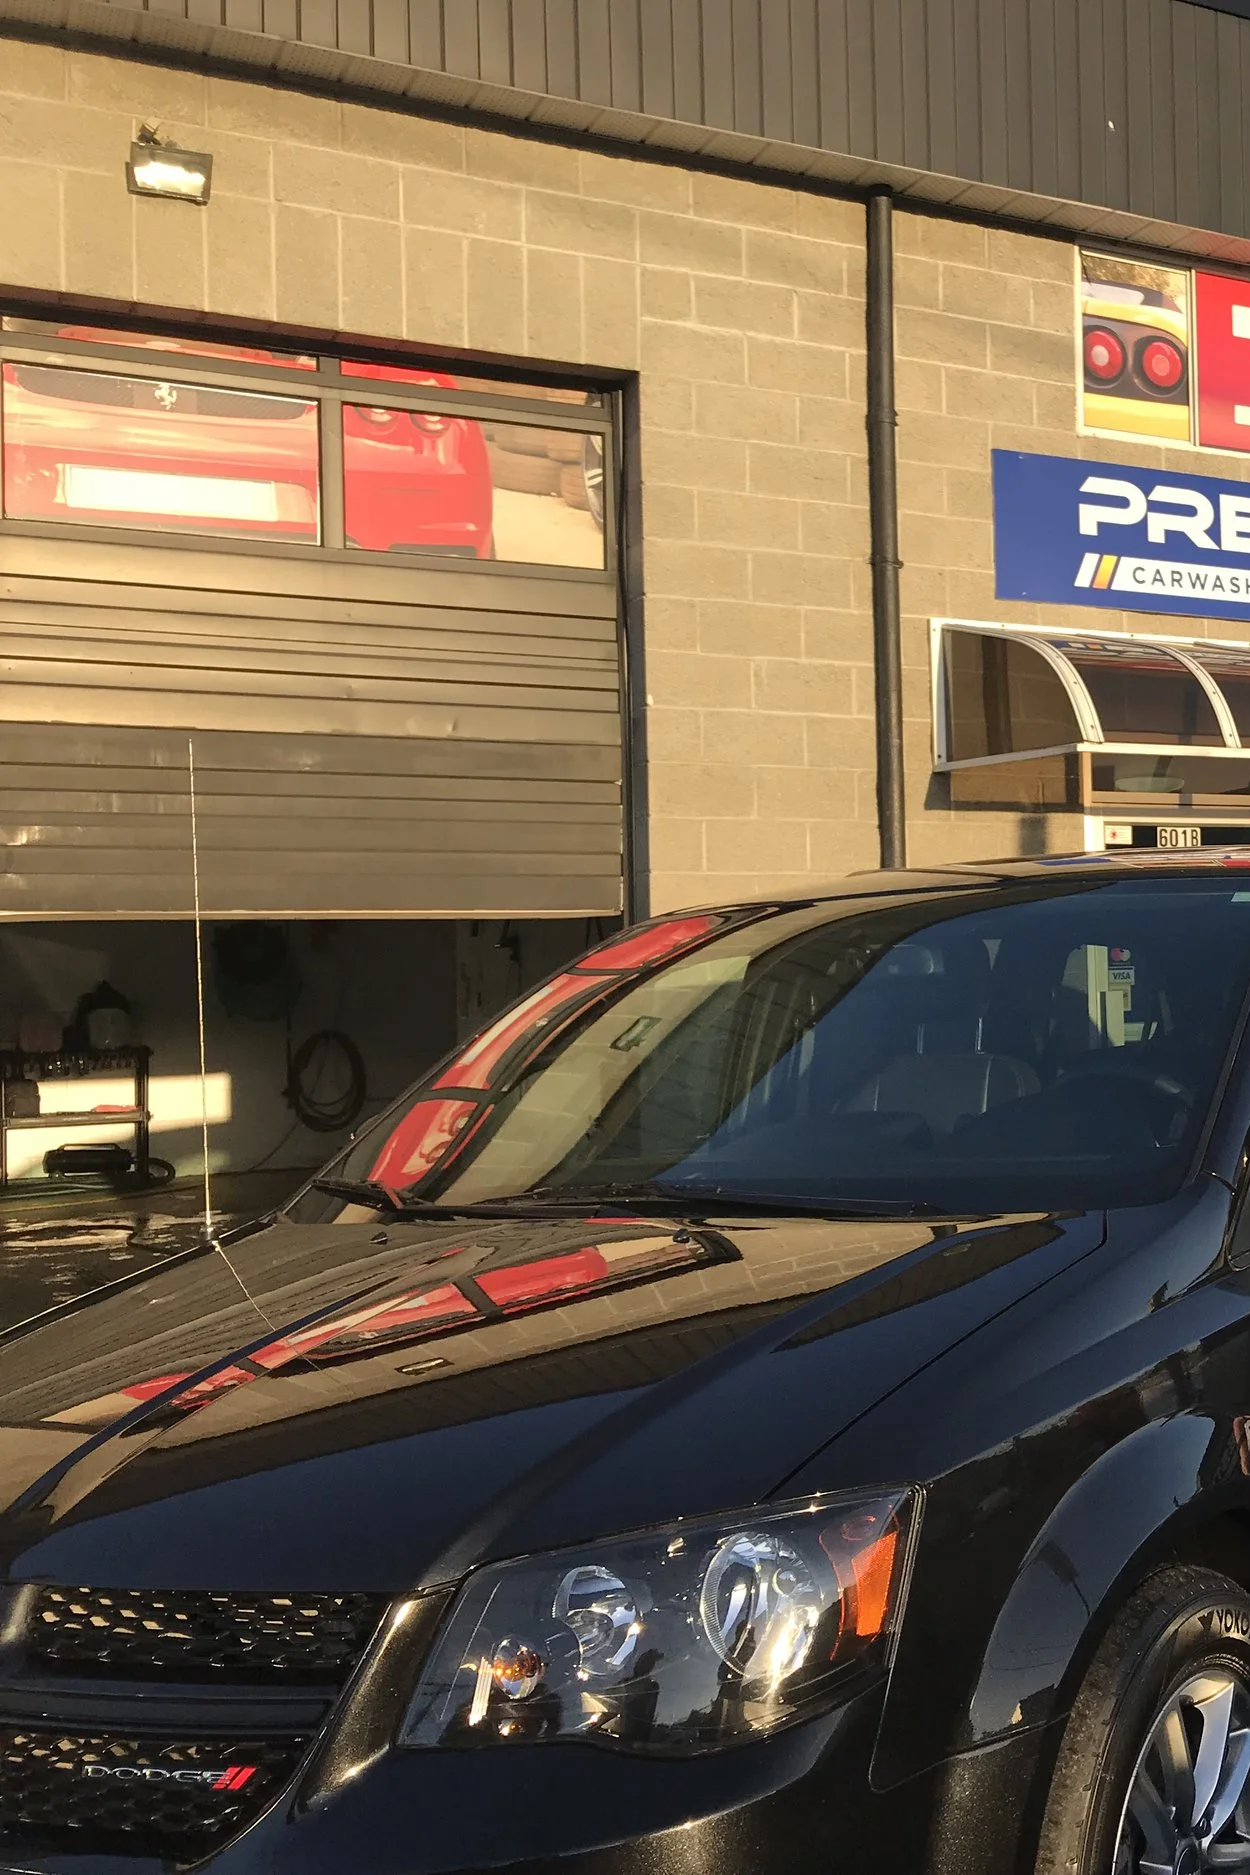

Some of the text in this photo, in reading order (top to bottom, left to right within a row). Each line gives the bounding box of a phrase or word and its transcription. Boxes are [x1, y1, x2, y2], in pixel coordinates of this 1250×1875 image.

[1159, 828, 1199, 847] 601B
[1111, 972, 1132, 980] VISA
[82, 1765, 231, 1784] DODGE
